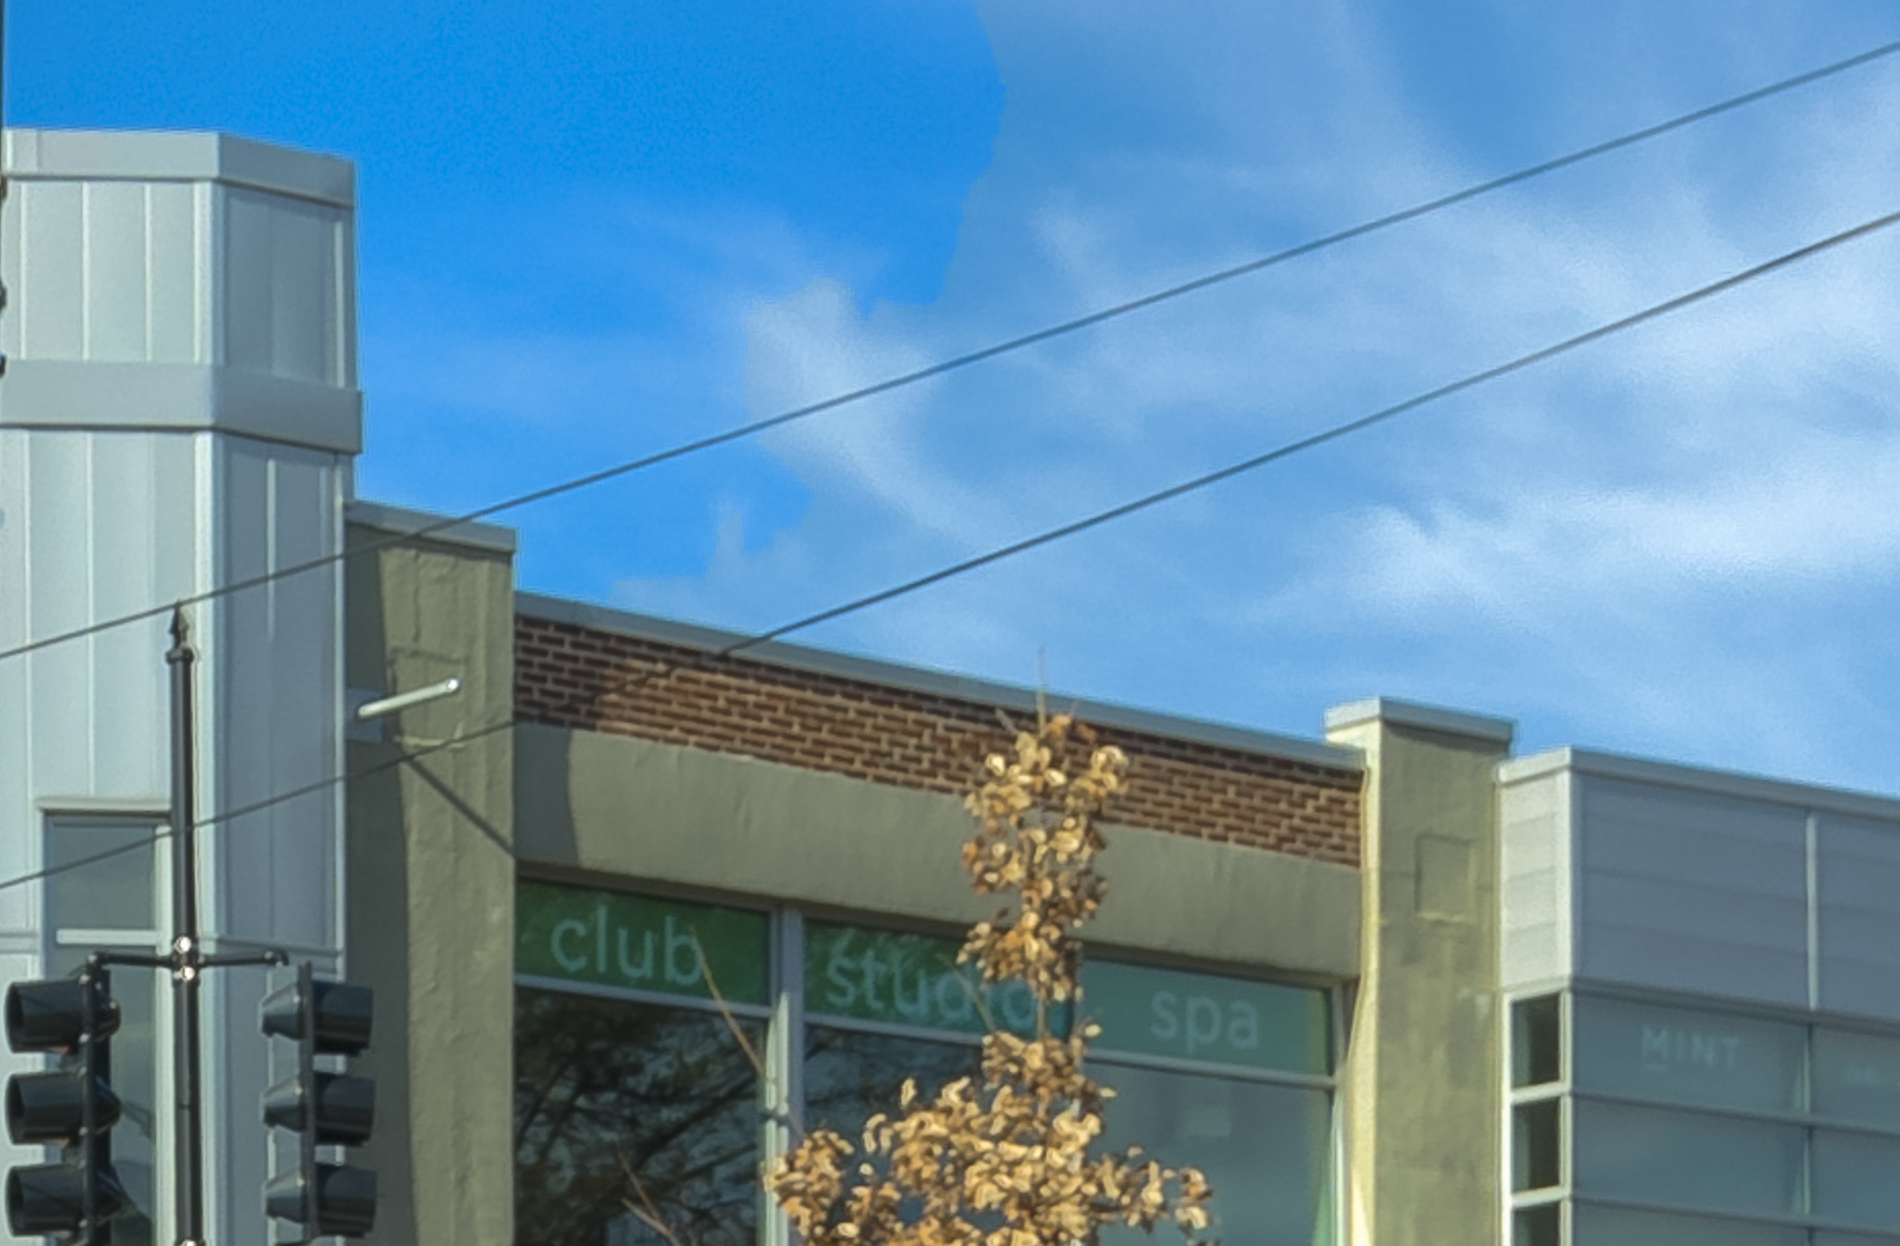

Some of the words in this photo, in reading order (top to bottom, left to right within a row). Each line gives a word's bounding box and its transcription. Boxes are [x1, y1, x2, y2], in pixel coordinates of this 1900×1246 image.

[550, 904, 704, 988] club
[1150, 990, 1261, 1055] spa
[1641, 1026, 1741, 1070] MINT
